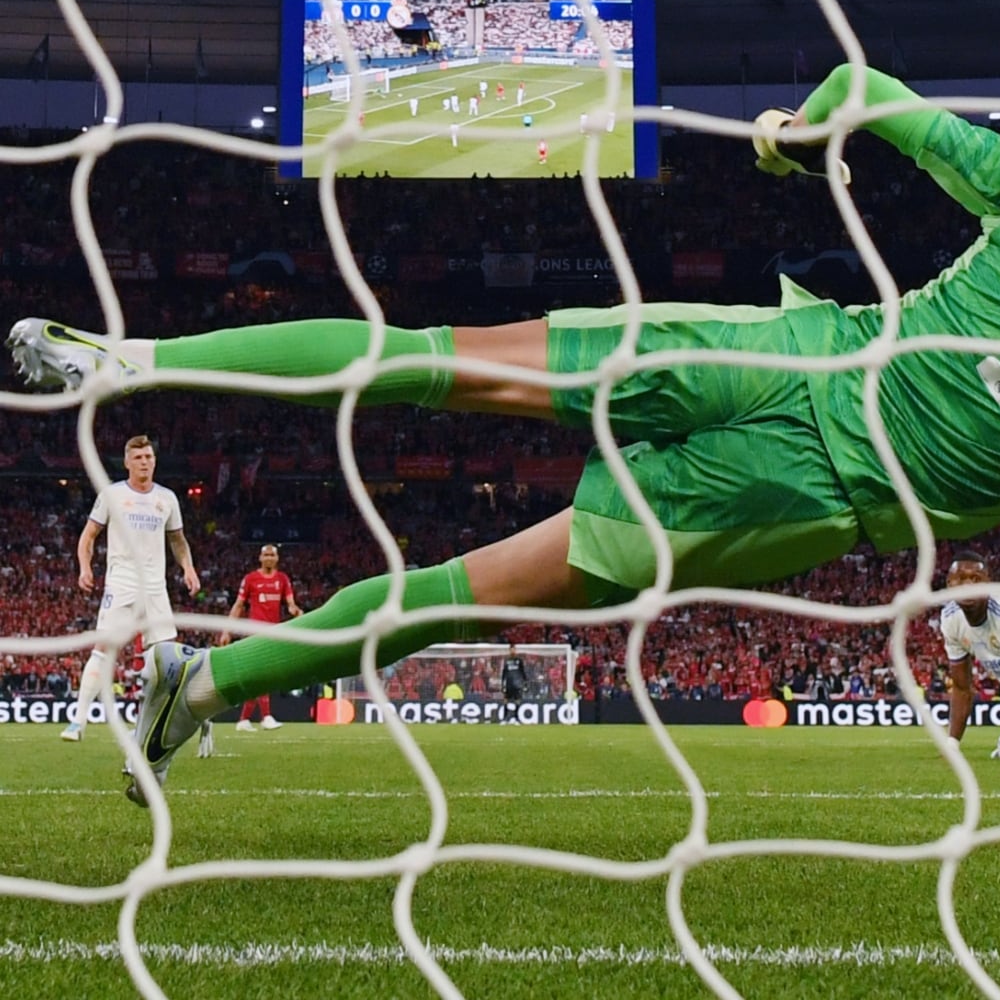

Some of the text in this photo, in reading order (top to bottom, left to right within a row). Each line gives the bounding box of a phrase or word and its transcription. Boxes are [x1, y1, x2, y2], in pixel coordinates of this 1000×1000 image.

[351, 4, 381, 18] 0 0
[561, 4, 599, 18] 20:
[365, 698, 580, 724] mastercard
